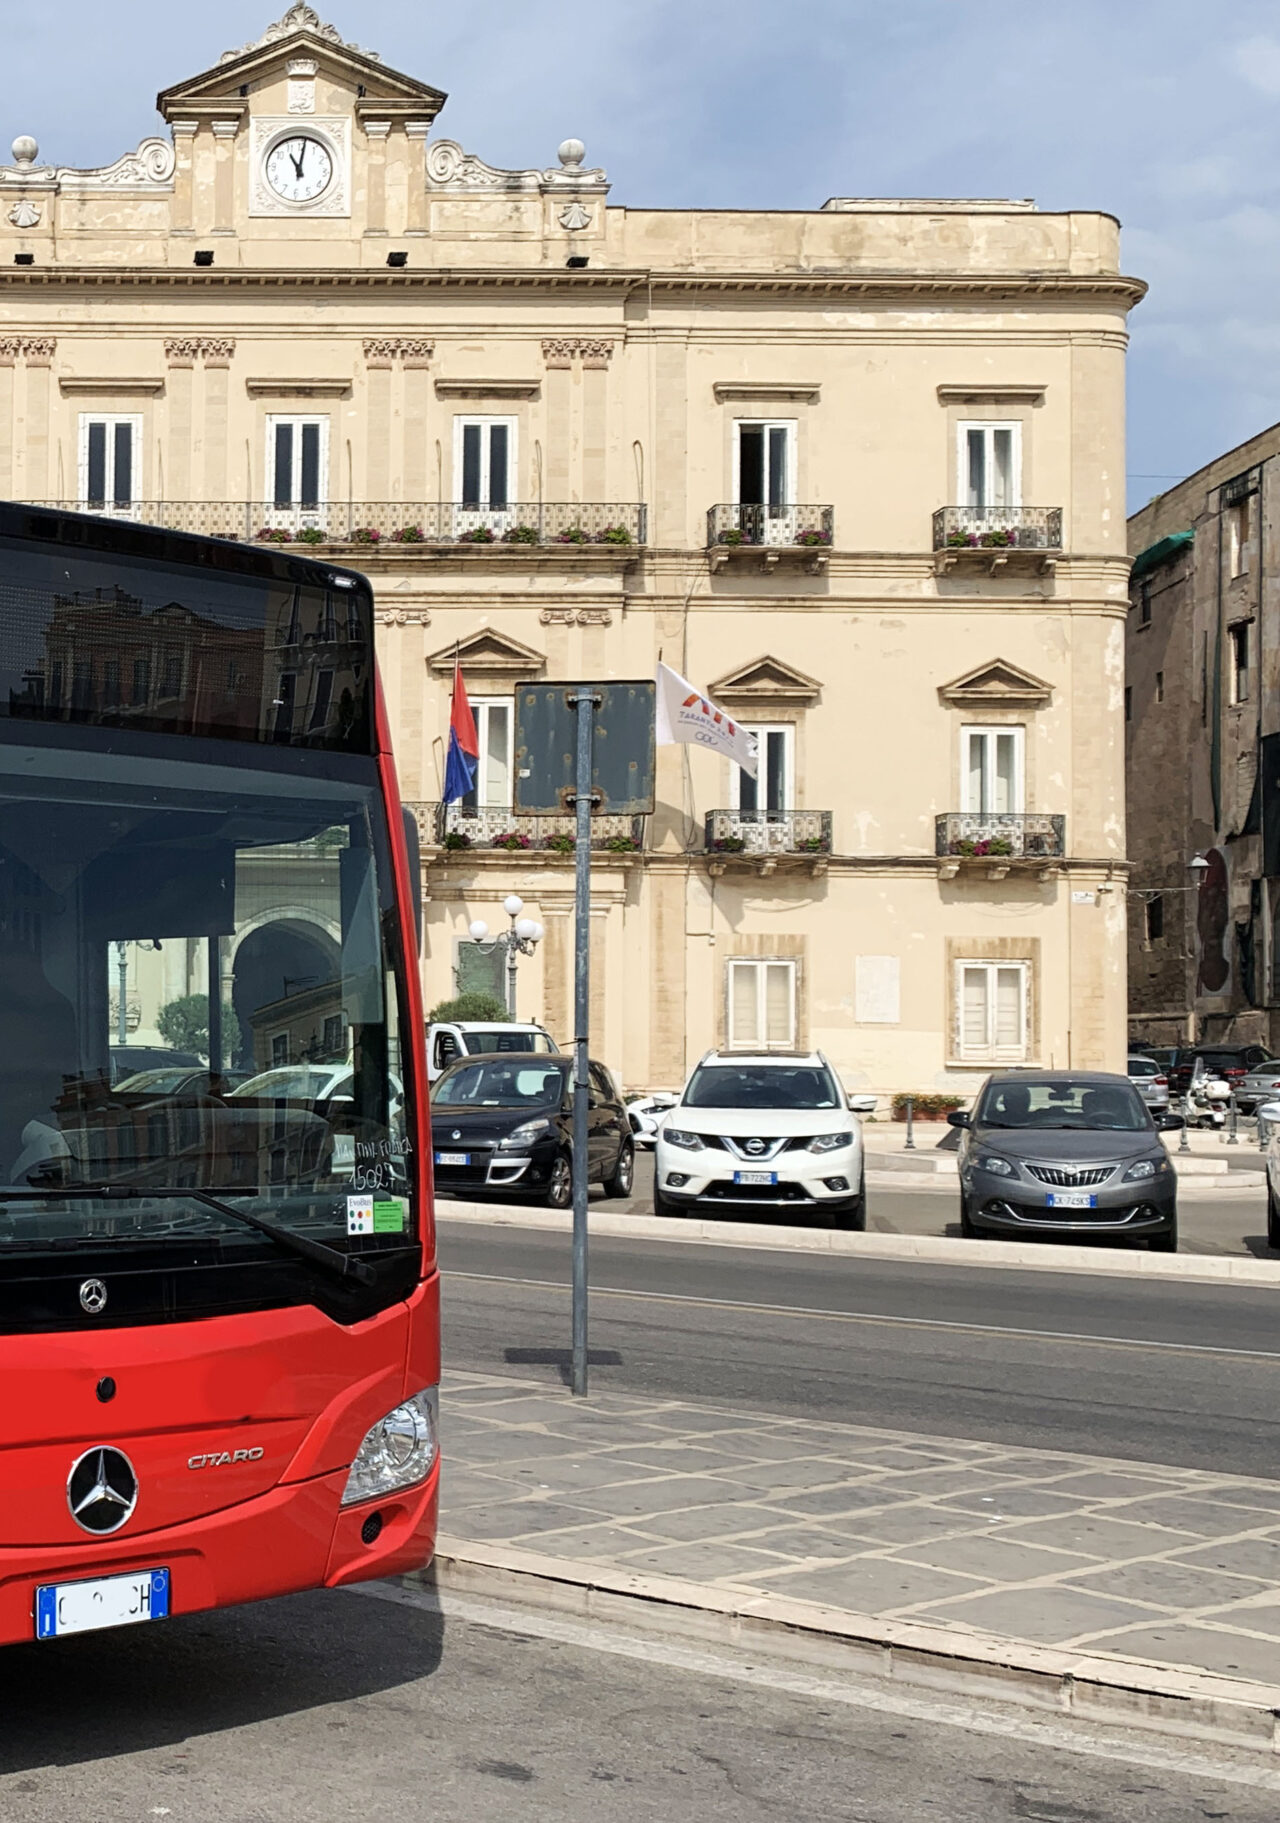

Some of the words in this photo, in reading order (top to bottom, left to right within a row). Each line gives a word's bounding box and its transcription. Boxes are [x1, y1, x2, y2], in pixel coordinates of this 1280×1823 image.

[679, 710, 716, 729] TARANTO
[349, 1197, 372, 1207] EvoBus
[187, 1446, 265, 1470] CITARO
